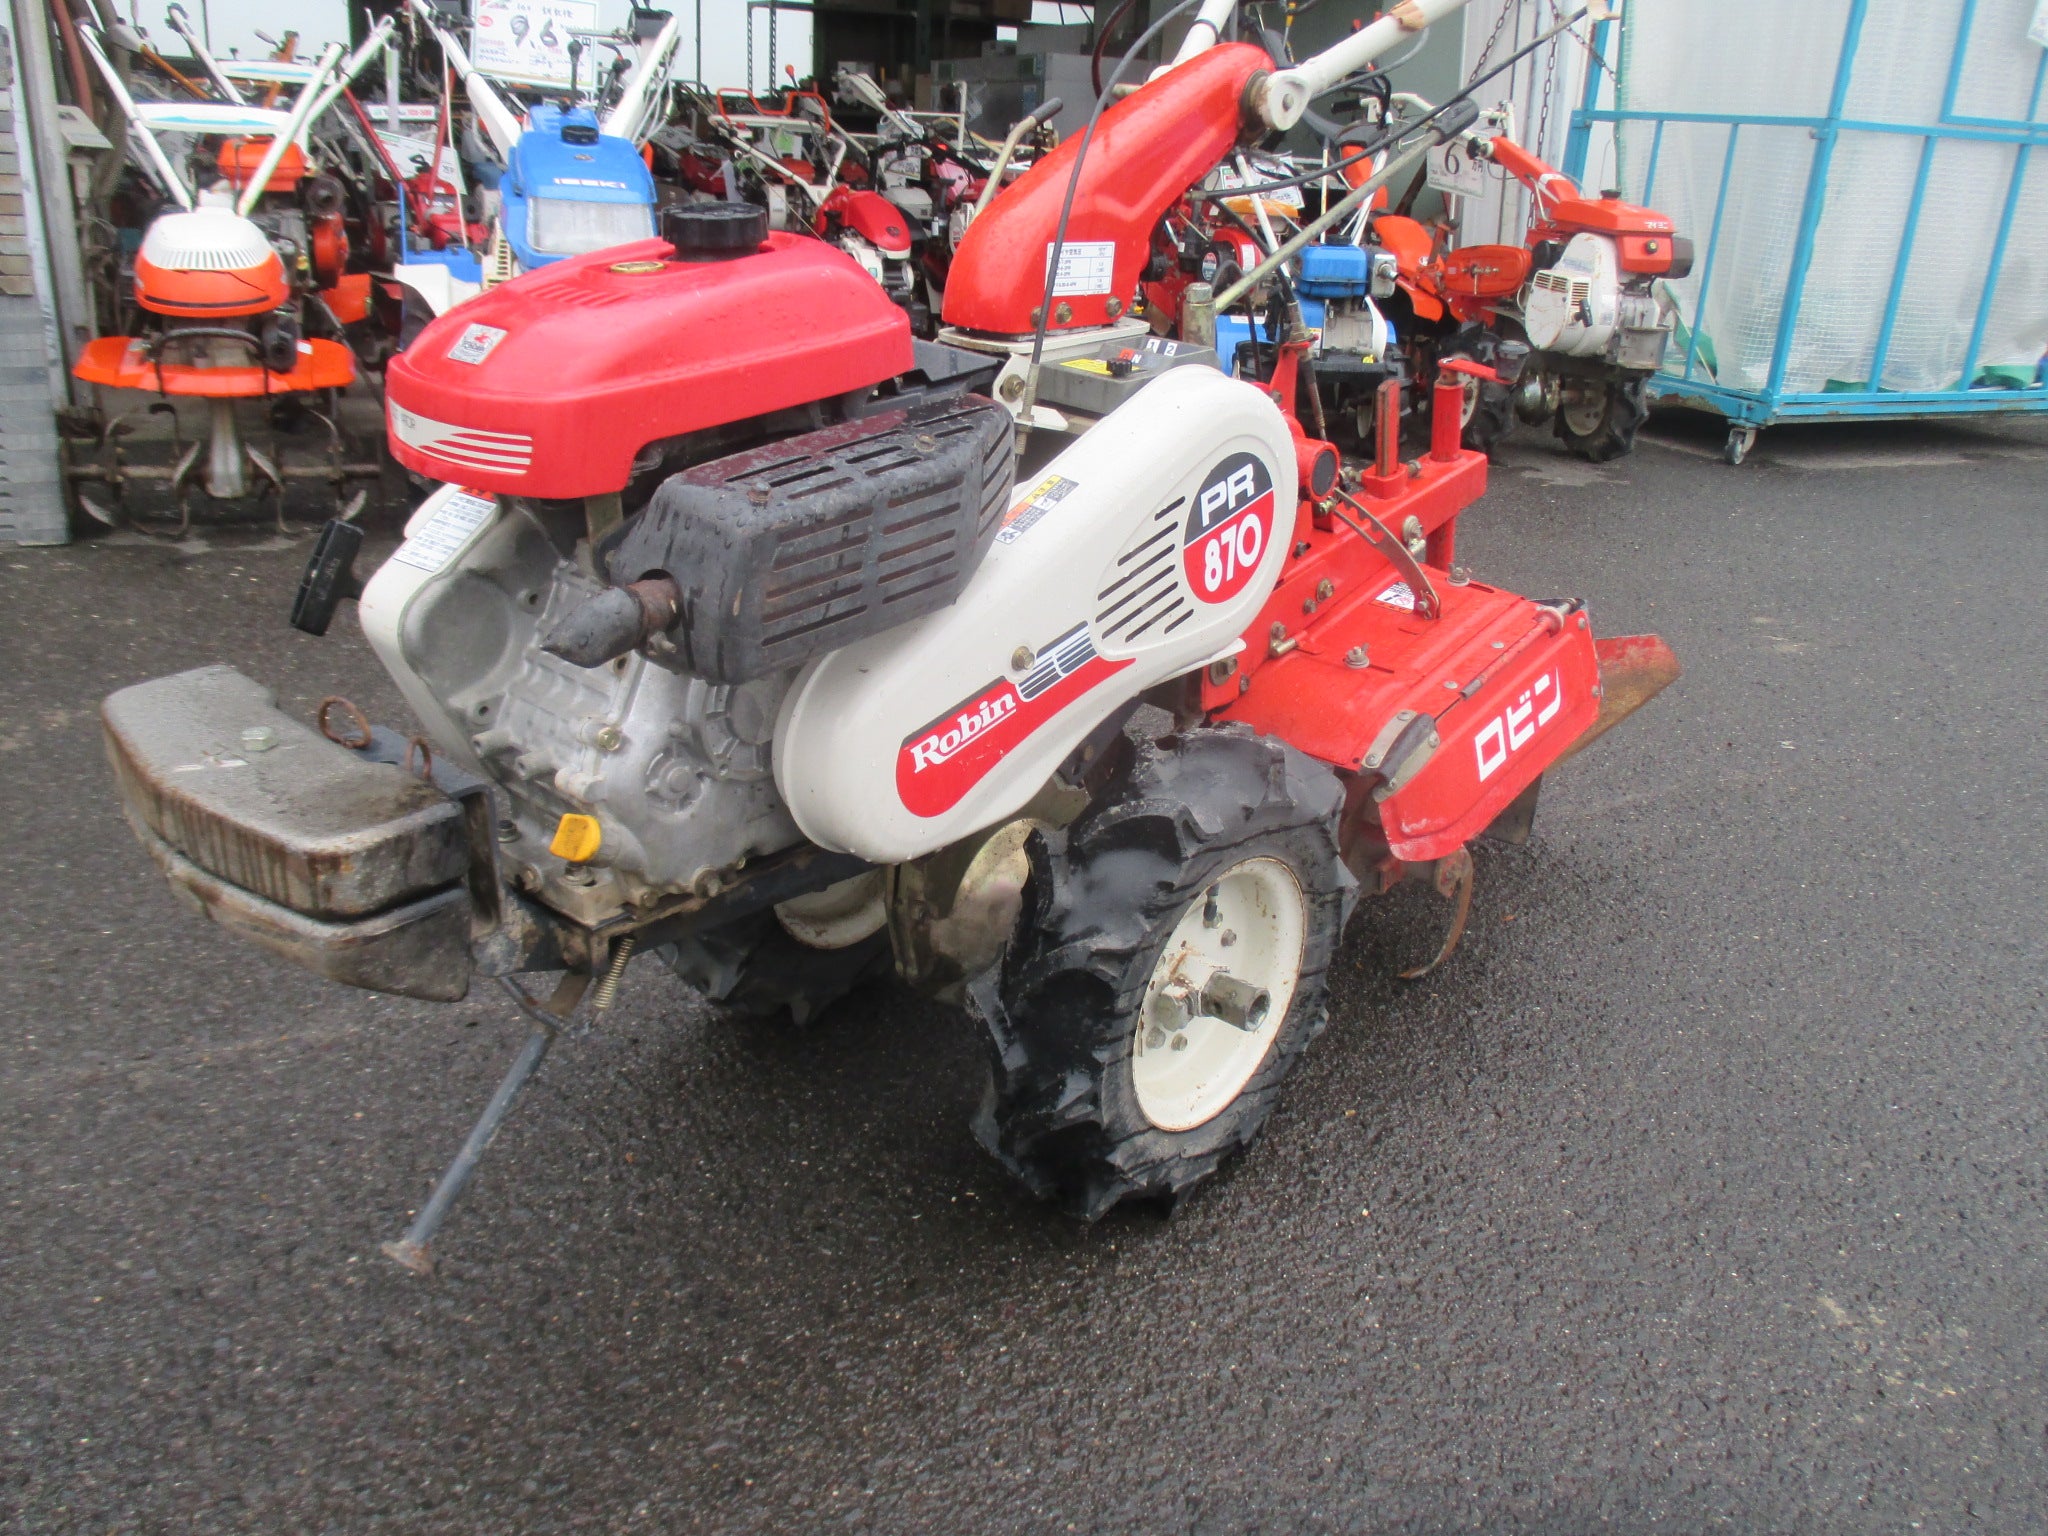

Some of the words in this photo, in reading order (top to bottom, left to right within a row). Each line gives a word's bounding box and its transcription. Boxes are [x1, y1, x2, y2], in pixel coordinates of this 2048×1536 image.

[553, 177, 626, 189] ISEKI
[1445, 141, 1460, 175] 6
[1200, 463, 1255, 528] PR
[1204, 513, 1262, 592] 870
[910, 693, 1016, 774] Robin
[1475, 666, 1561, 782] ロビン
